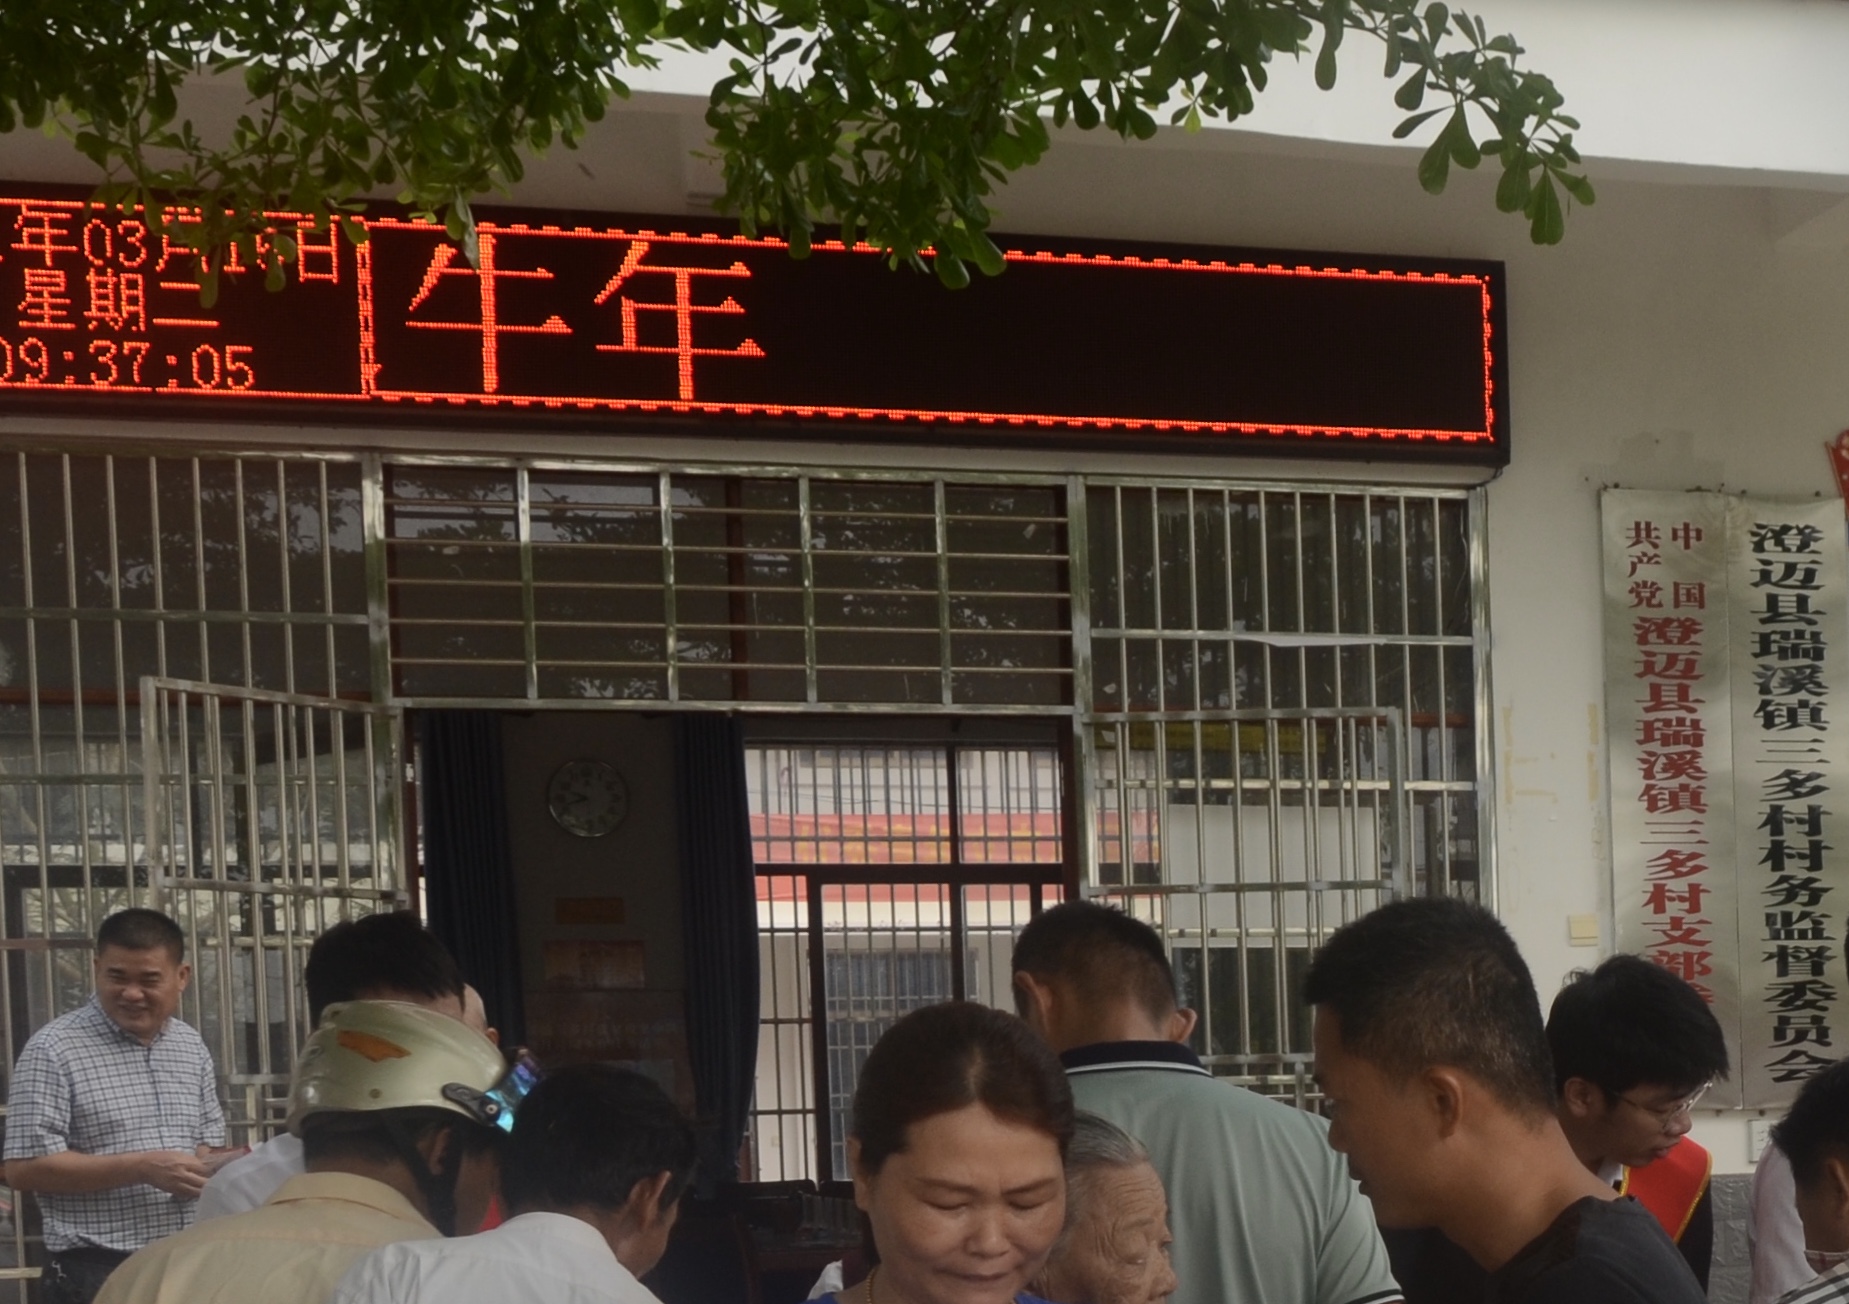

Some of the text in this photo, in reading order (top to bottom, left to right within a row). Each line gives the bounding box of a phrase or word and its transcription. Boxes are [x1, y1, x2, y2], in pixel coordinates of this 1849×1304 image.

[17, 267, 221, 331] 星期二
[405, 222, 766, 399] 牛年
[1632, 615, 1714, 1004] 澄迈县瑞溪镇三多村支部
